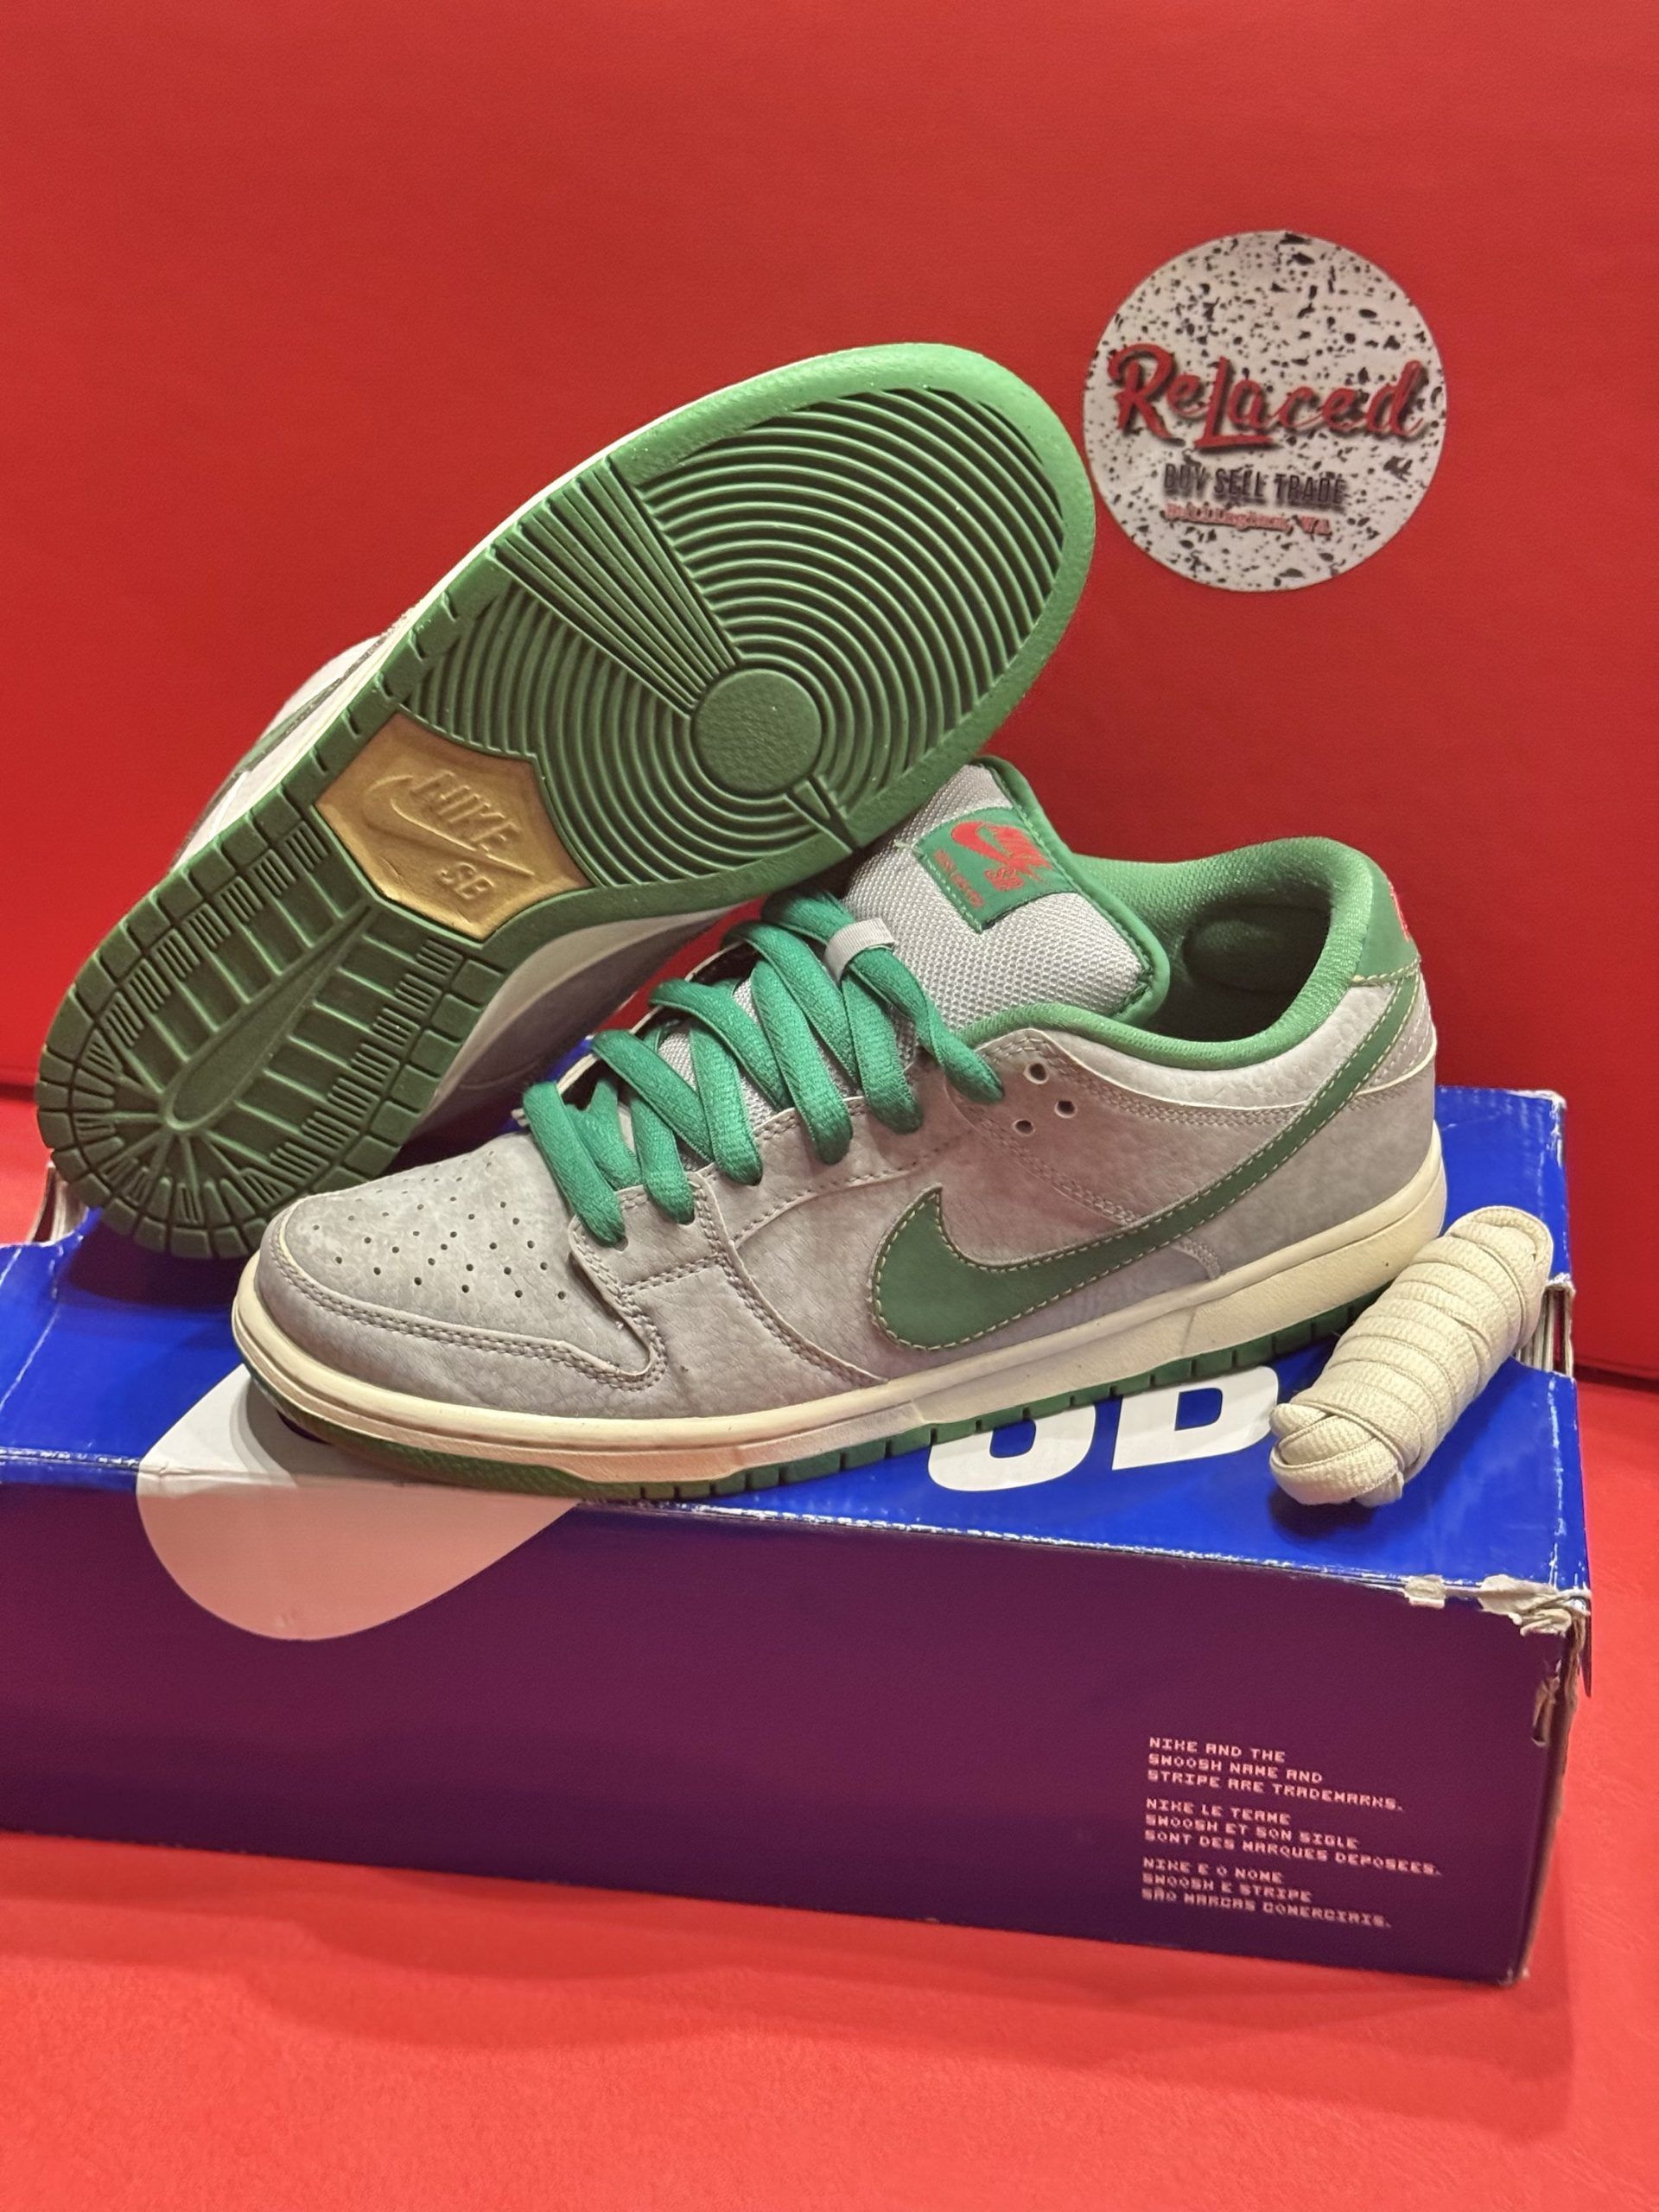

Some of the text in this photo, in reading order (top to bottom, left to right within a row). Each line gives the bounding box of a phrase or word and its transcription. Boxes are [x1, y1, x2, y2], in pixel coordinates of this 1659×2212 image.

[1107, 342, 1429, 453] ReLaced
[1164, 463, 1346, 505] BUY SELL TRADE
[410, 769, 524, 851] NIKE
[438, 861, 494, 900] SB
[1148, 1752, 1323, 1784] SWOOSH NAME AND
[1149, 1737, 1286, 1764] NIKE AND THE
[1146, 1797, 1195, 1815] NIKE
[1201, 1803, 1223, 1817] LE
[1147, 1769, 1404, 1811] STRIPE ARE TRADEMARKS.
[1145, 1829, 1192, 1845] SONT
[1199, 1835, 1235, 1850] DES
[1243, 1840, 1328, 1862] MARQUES
[1146, 1814, 1361, 1851] SWOOSH ET SON SIGLE
[1142, 1872, 1313, 1904] SWOOSH E STRIPE
[1143, 1857, 1191, 1874] NIKE
[1217, 1866, 1228, 1877] O
[1235, 1867, 1284, 1885] NOME
[1184, 1892, 1256, 1912] MARCAS
[1262, 1901, 1392, 1928] COMERCIAIS.
